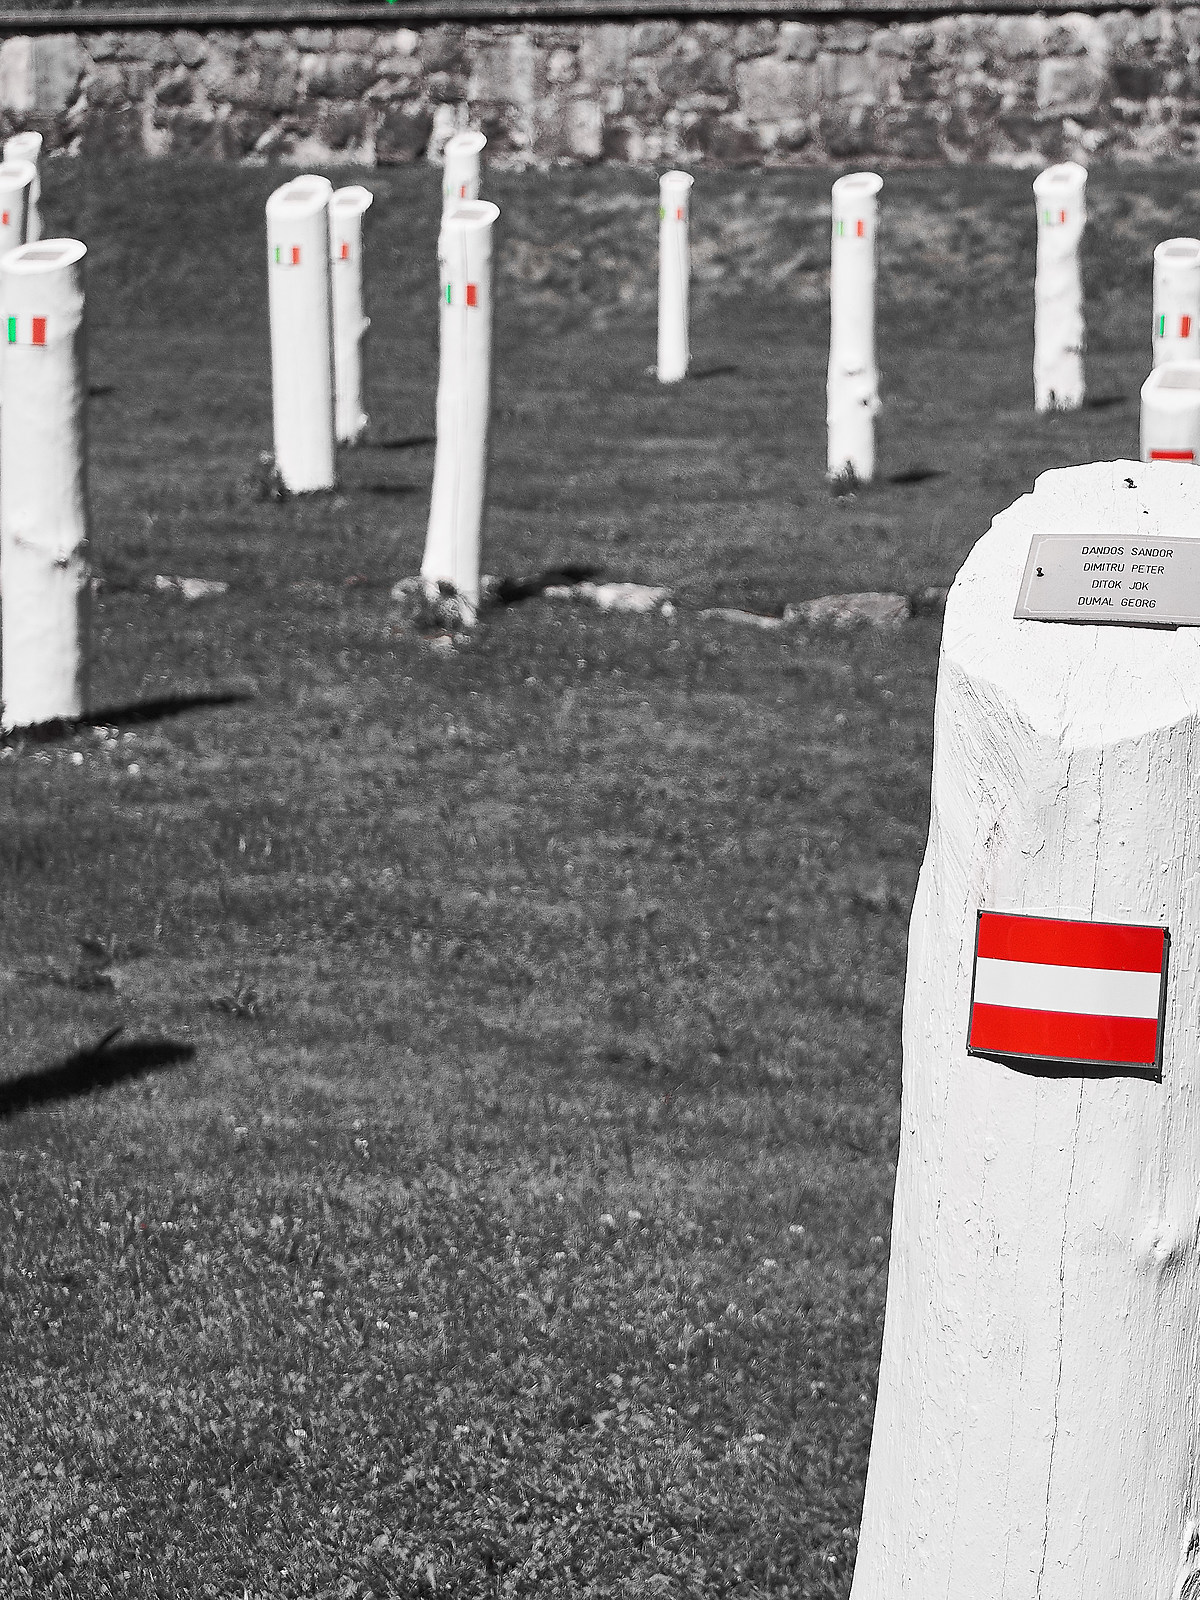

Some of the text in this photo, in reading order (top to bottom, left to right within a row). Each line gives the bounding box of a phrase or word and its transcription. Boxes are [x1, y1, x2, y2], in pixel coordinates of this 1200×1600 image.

[1081, 546, 1174, 558] DANDOS SANDOR
[1083, 562, 1165, 574] DIMITRU PETER
[1091, 580, 1149, 591] DITOK JOK
[1077, 596, 1157, 608] DUMAL GEORG
